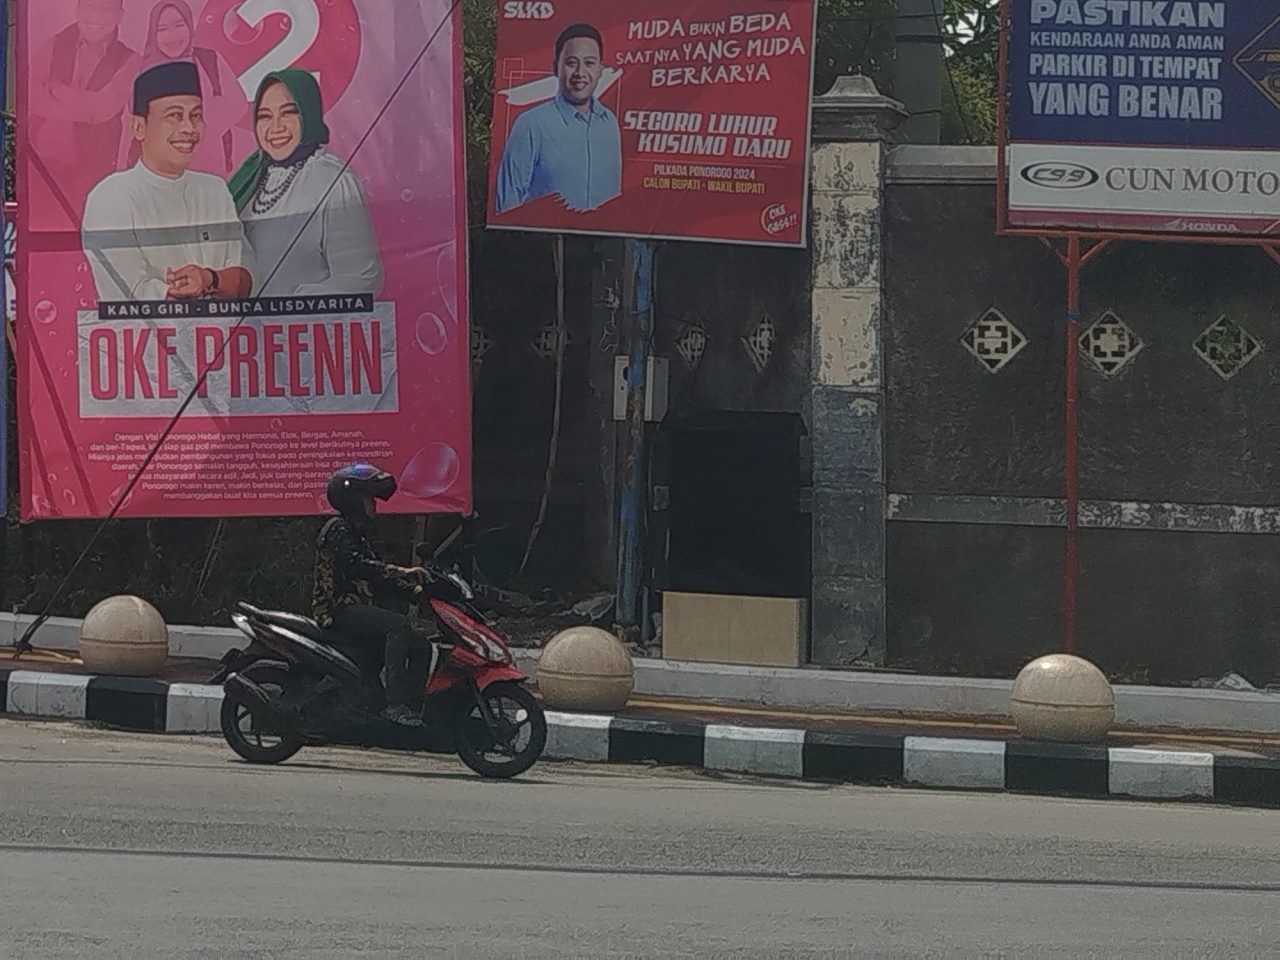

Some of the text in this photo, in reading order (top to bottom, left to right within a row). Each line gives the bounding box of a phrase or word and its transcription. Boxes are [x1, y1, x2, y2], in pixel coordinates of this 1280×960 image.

[628, 12, 792, 40] MUDA BIKIN BEDA
[1030, 0, 1225, 28] PASTIKAN
[683, 39, 741, 63] YANG
[746, 37, 806, 57] MUDA
[1030, 31, 1224, 51] KENDARAAN ANDA AMAN
[651, 63, 771, 88] BERKARYA
[1029, 53, 1222, 80] PARKIR DI TEMPAT
[1028, 82, 1223, 120] YANG BENAR
[623, 110, 777, 136] SEGORO LUHUR
[638, 133, 792, 159] KUSUMO DARU
[654, 164, 755, 180] PILKADA PONOROGO 2024
[1105, 167, 1175, 191] CUN
[1183, 168, 1280, 196] MOTO
[643, 177, 765, 195] CALON BUPATI WAKIL BUPATI
[769, 204, 786, 219] OKE
[1181, 222, 1240, 232] HONDA
[107, 303, 153, 317] KANG
[157, 302, 190, 315] GIRI
[208, 300, 263, 314] BUNDA
[270, 297, 365, 313] LISDYARITA
[90, 320, 384, 401] OKE PREENN
